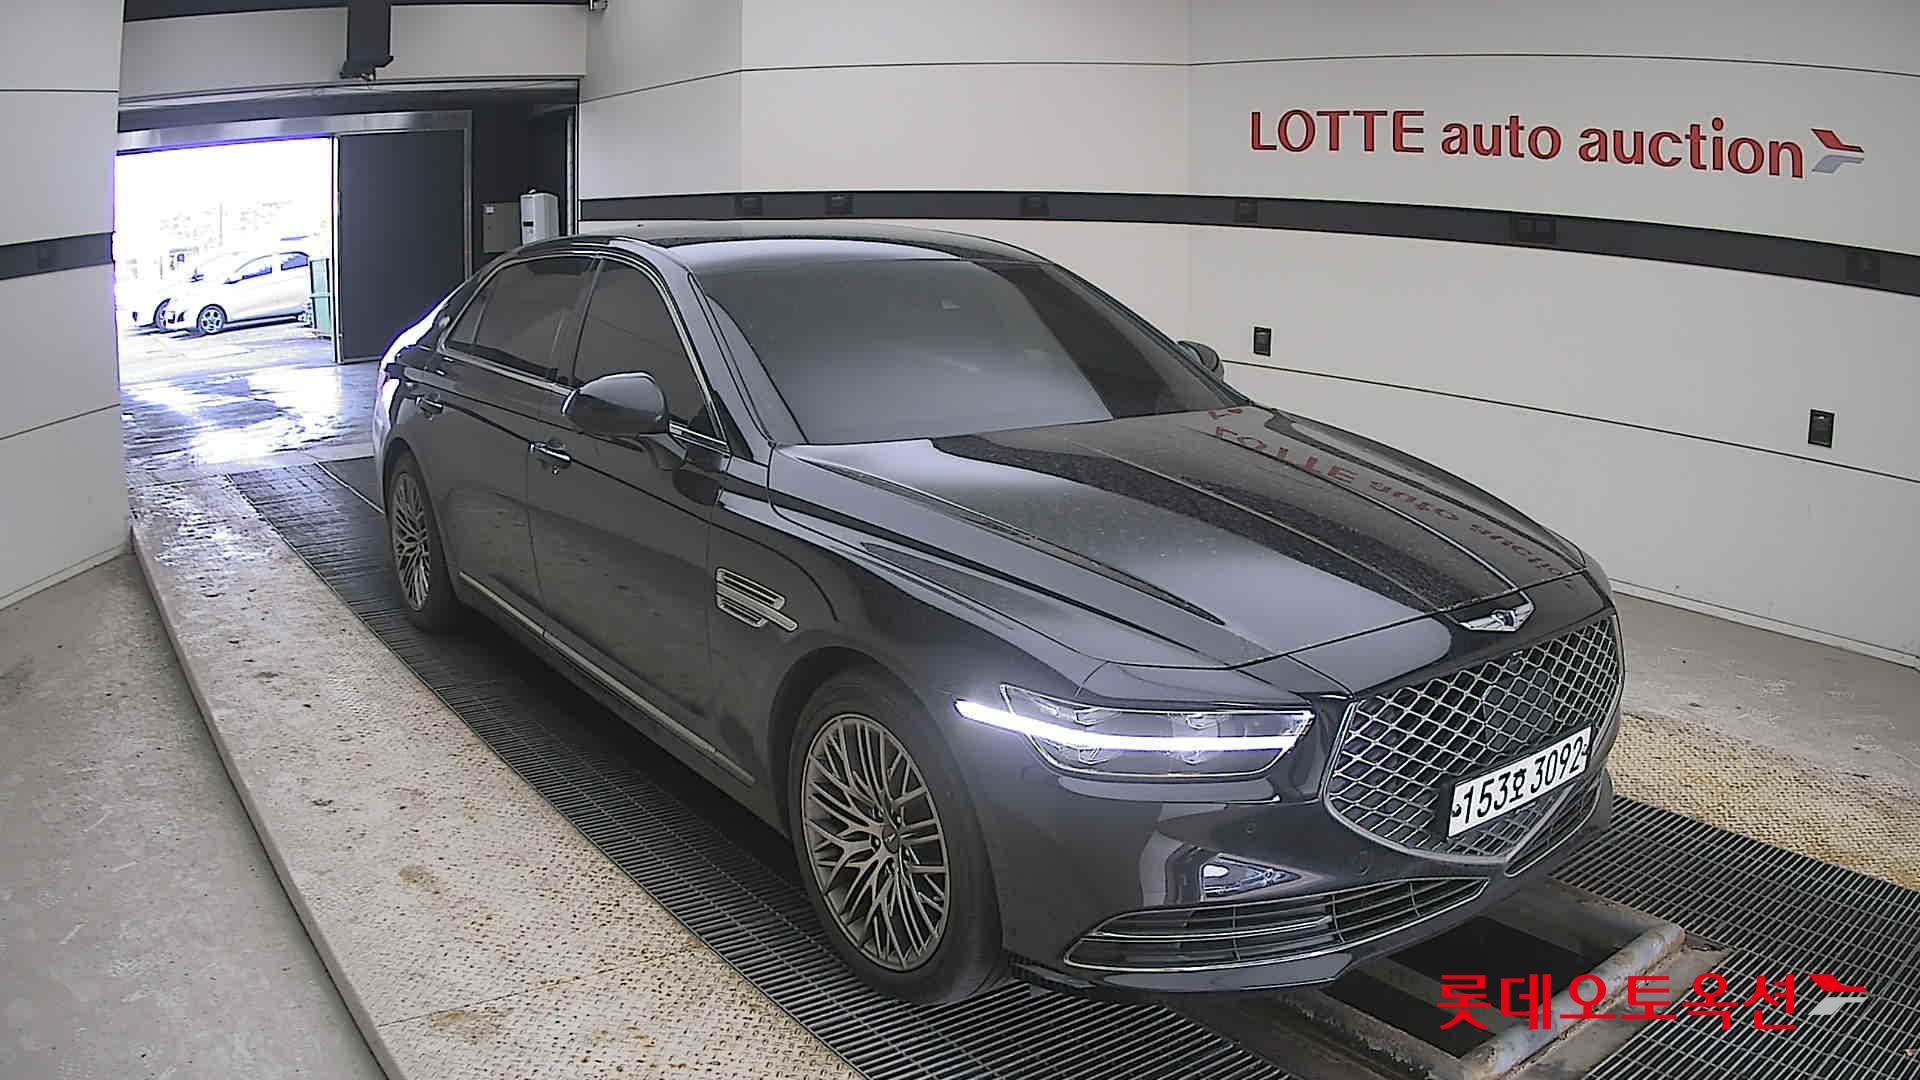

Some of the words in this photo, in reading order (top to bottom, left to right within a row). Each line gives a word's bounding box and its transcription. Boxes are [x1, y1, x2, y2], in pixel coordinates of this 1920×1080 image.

[1250, 110, 1425, 153] LOTTE
[1441, 116, 1562, 160] auto
[1577, 116, 1804, 178] auction
[1530, 736, 1584, 794] 3092
